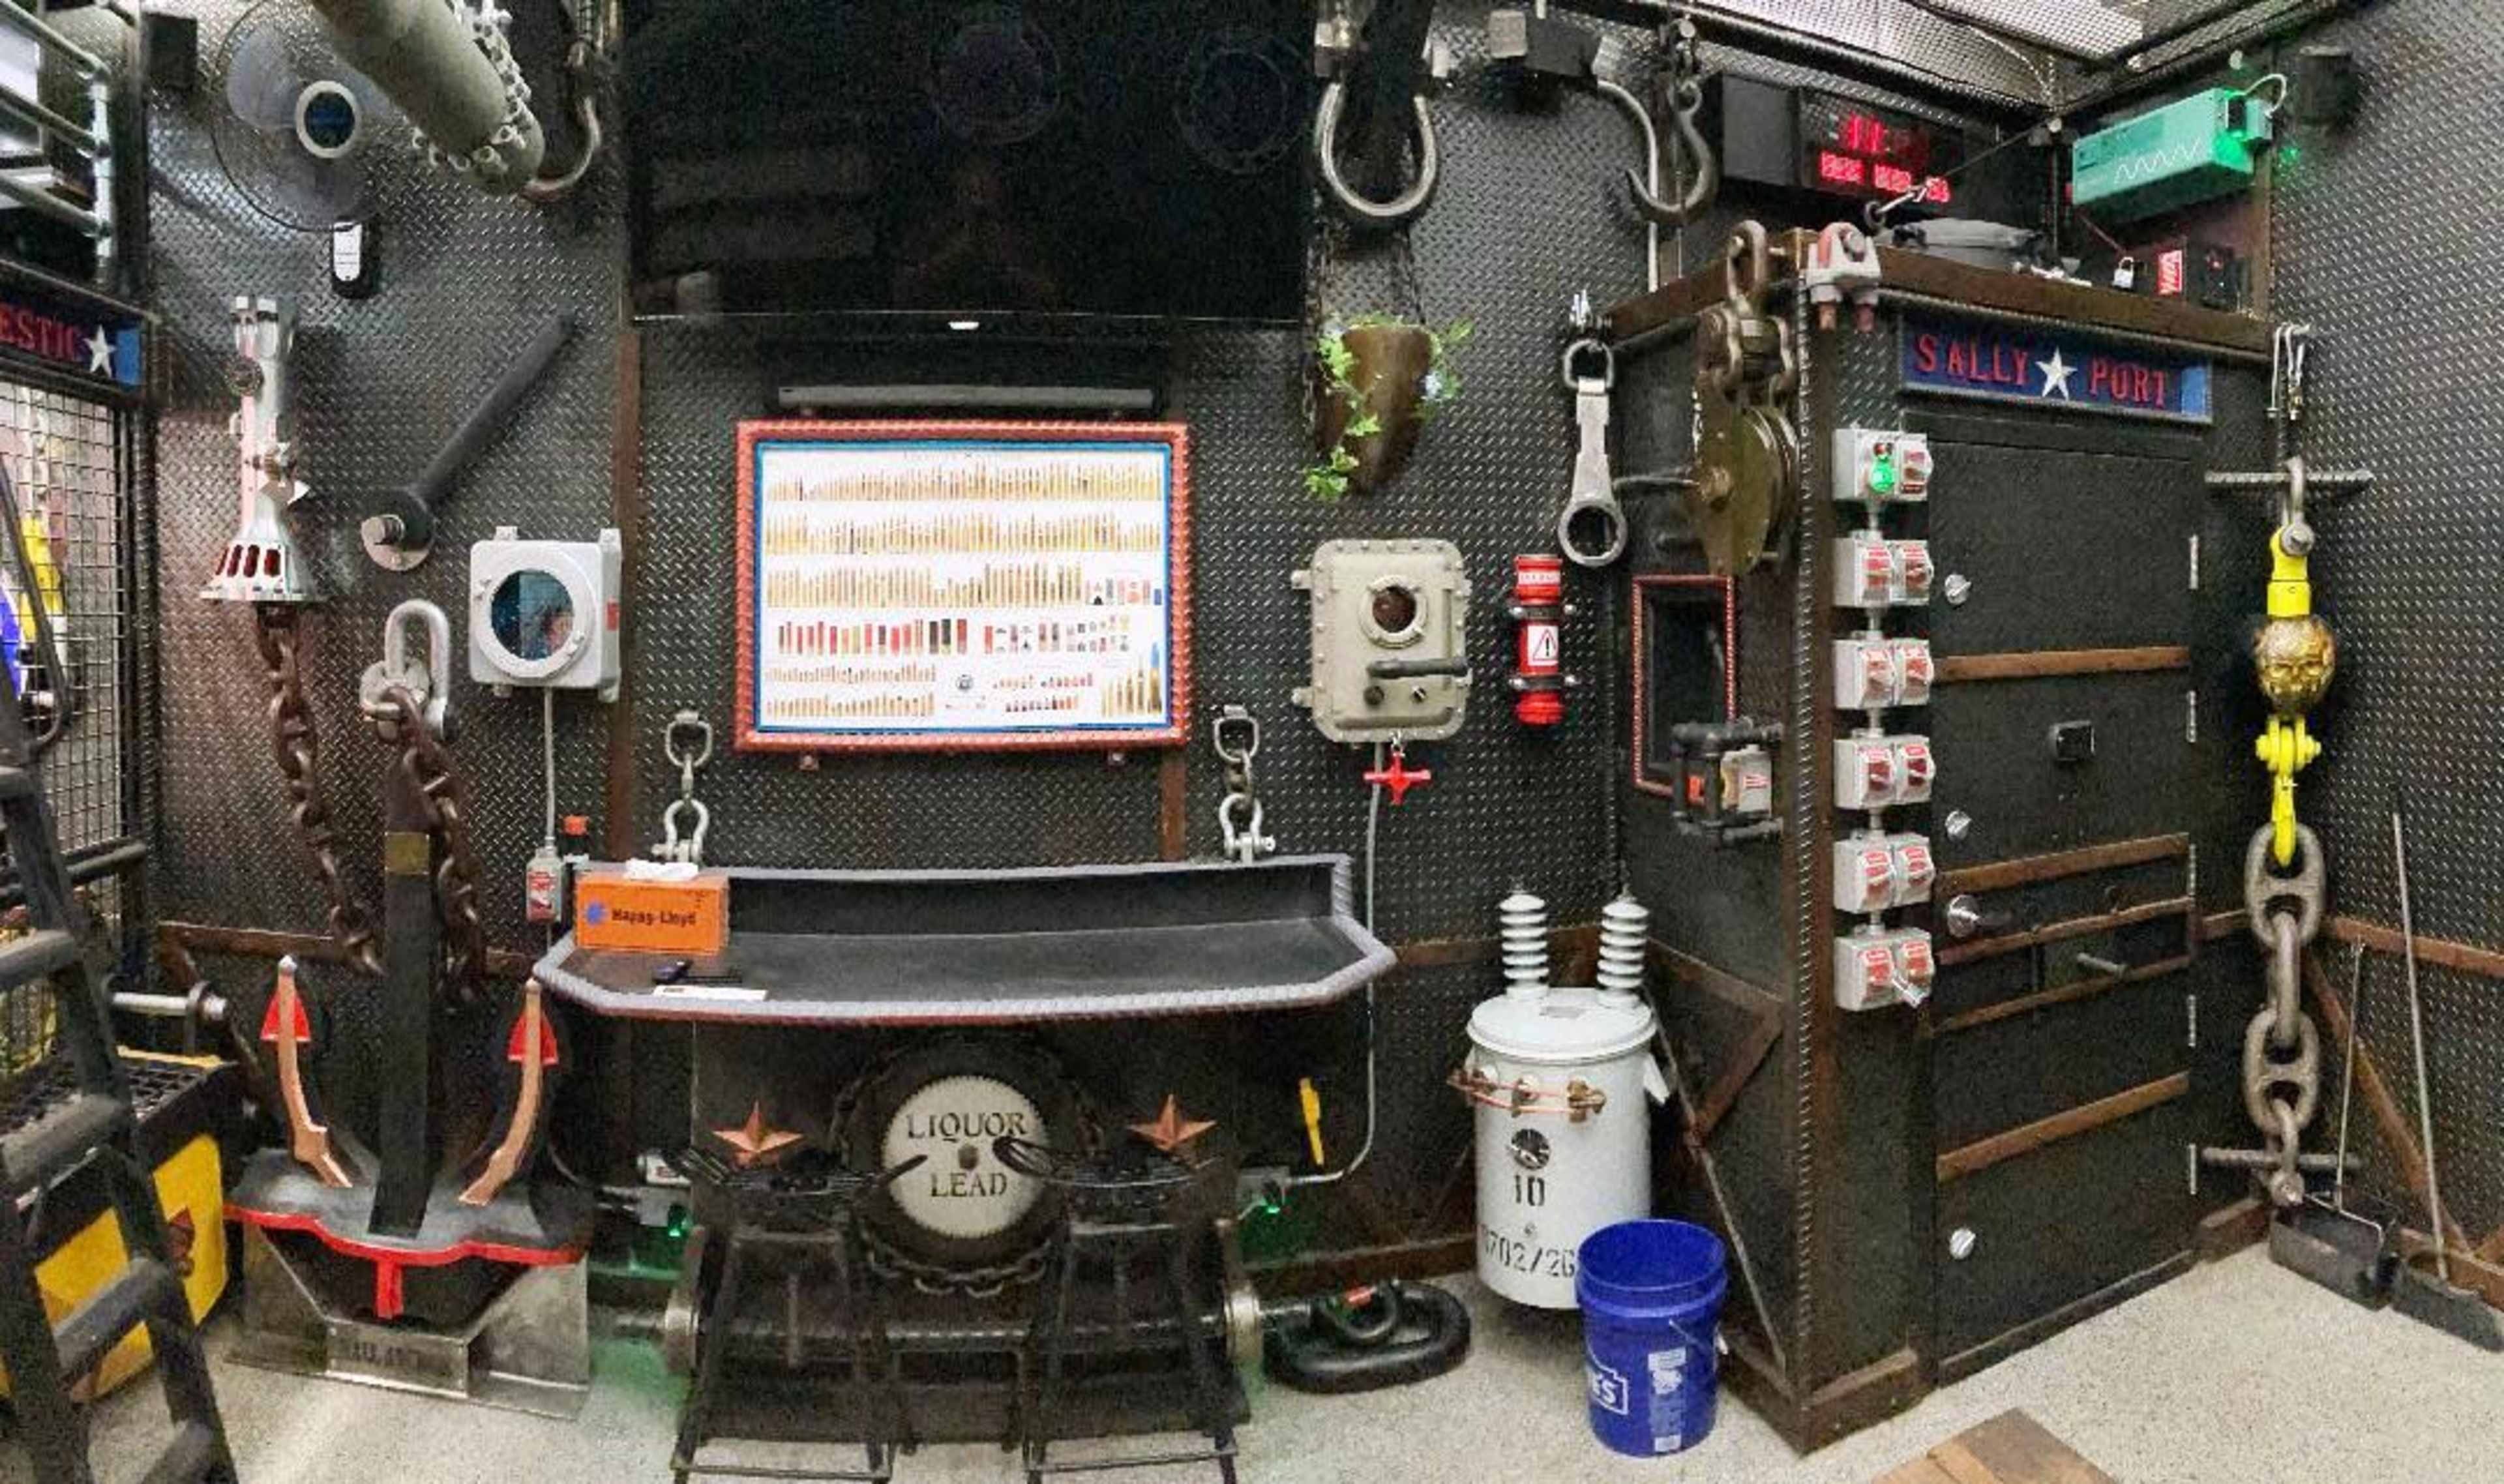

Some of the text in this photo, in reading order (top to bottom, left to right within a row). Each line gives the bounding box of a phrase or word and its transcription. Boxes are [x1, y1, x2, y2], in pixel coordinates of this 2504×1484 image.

[1916, 333, 2168, 408] SALLY PORT
[906, 1112, 1028, 1144] LIQUOR
[929, 1172, 1007, 1198] LEAD
[1514, 1174, 1545, 1206] 10
